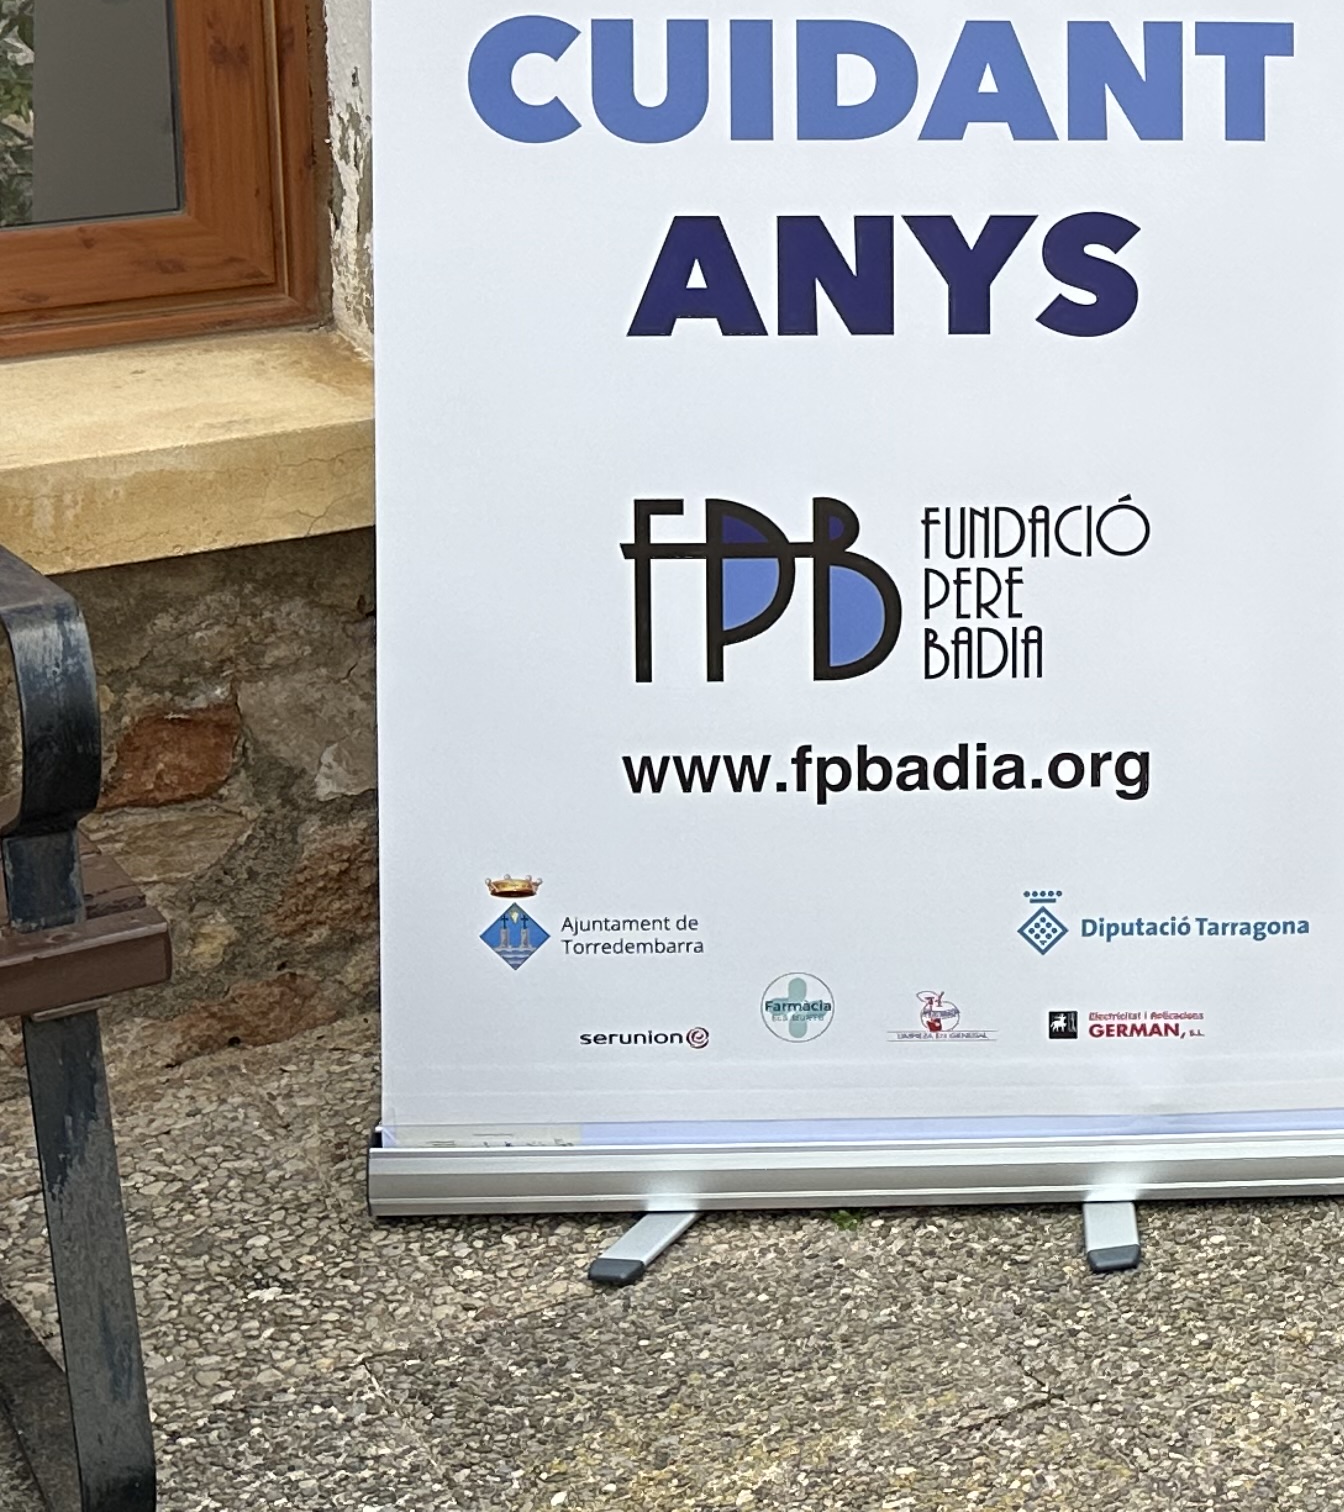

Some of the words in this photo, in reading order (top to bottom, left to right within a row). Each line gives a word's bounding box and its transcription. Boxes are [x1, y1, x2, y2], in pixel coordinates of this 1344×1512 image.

[467, 14, 1295, 144] CUIDANT
[626, 211, 1141, 337] ANYS
[921, 494, 1151, 559] FUNDACIÓ
[619, 497, 903, 683] FPB
[924, 567, 1024, 619] PERE
[924, 626, 1043, 680] BADIA
[622, 742, 1150, 805] www.fpbadia.org
[561, 915, 670, 936] Ajuntament
[676, 915, 699, 932] de
[561, 938, 704, 955] Torredembarra
[1081, 915, 1191, 942] Diputació
[1195, 917, 1310, 941] Tarragona
[765, 1000, 832, 1012] Farmàcia
